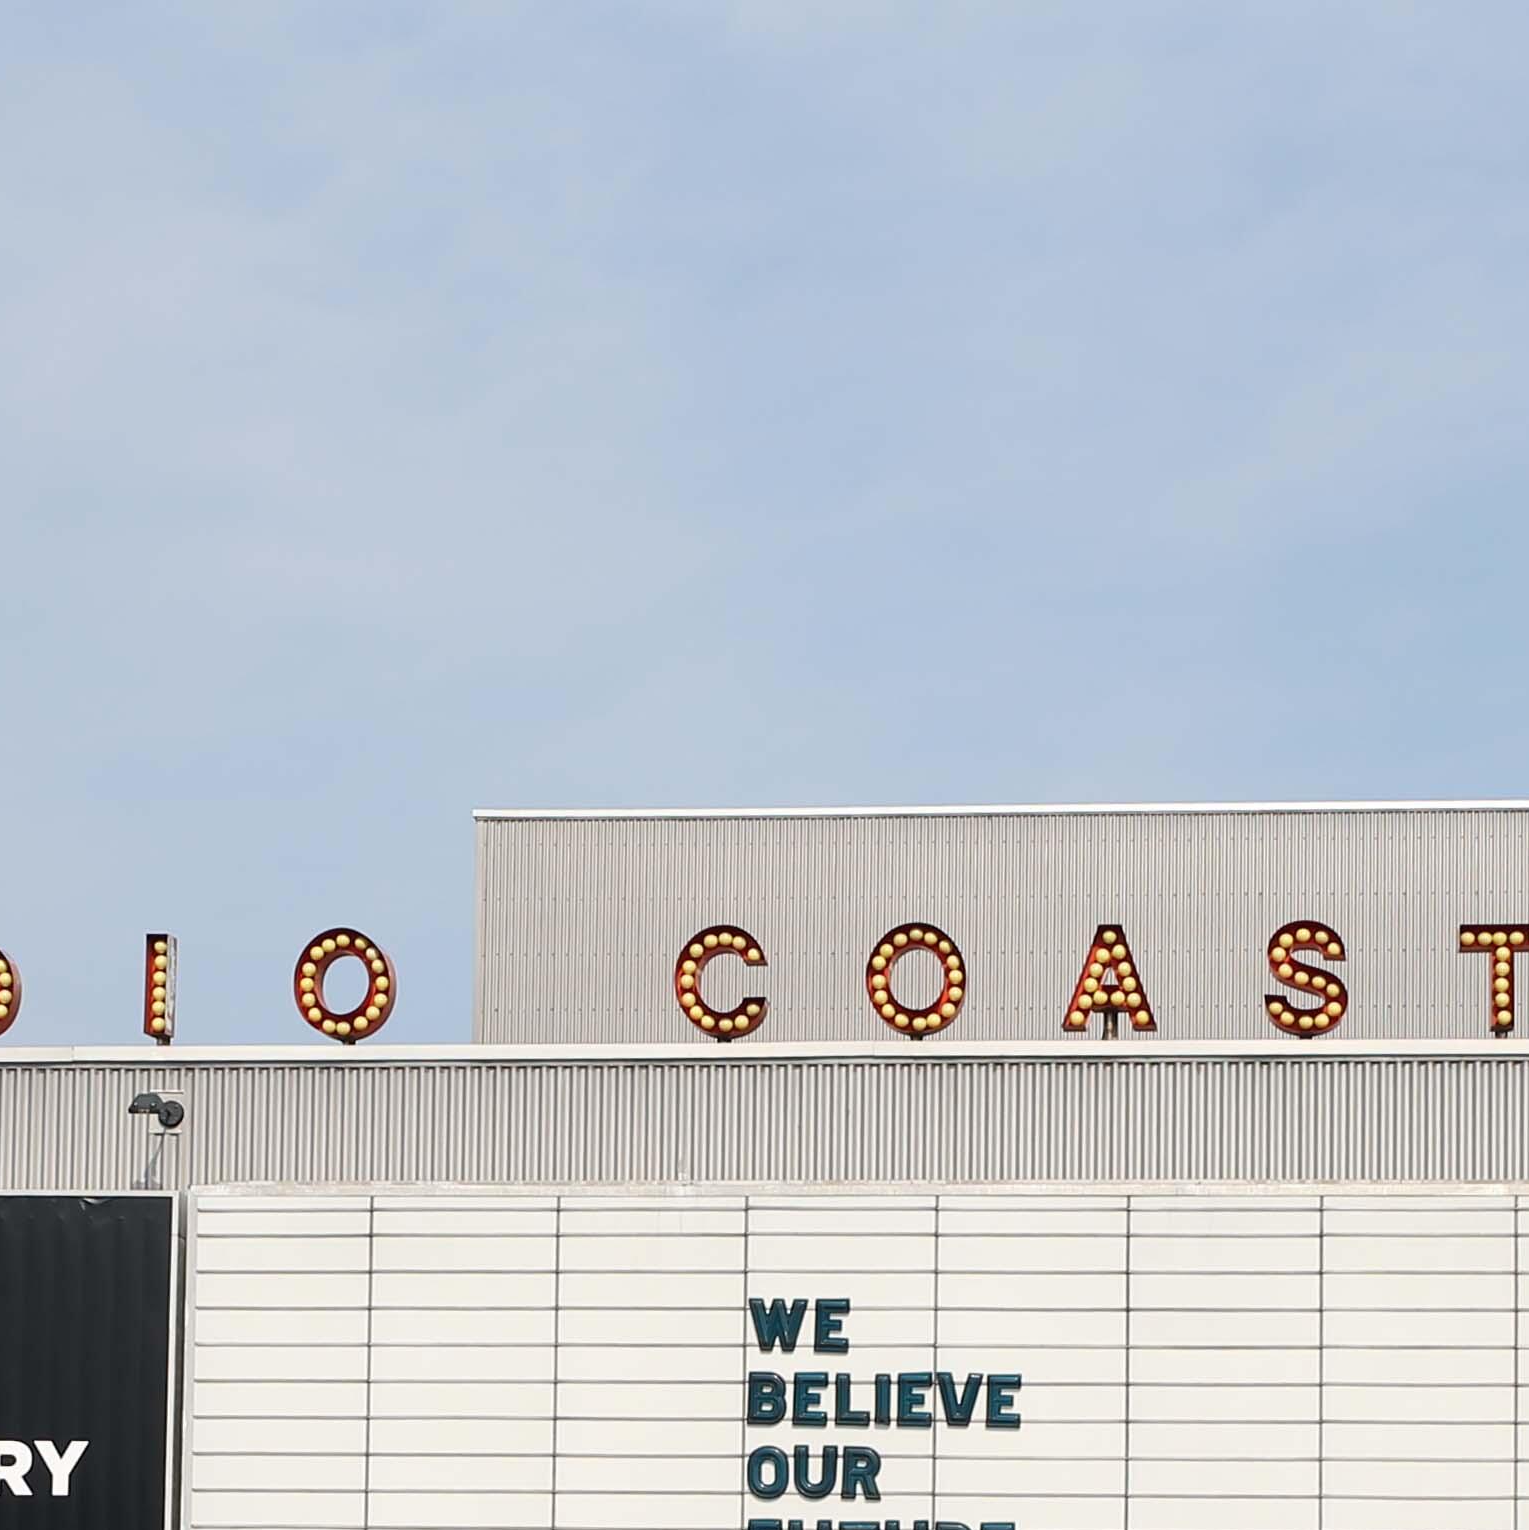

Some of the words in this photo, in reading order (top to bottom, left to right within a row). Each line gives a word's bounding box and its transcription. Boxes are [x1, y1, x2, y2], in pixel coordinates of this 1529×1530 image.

[748, 1298, 851, 1353] WE
[747, 1371, 1023, 1429] BELIEVE
[747, 1445, 882, 1502] OUR
